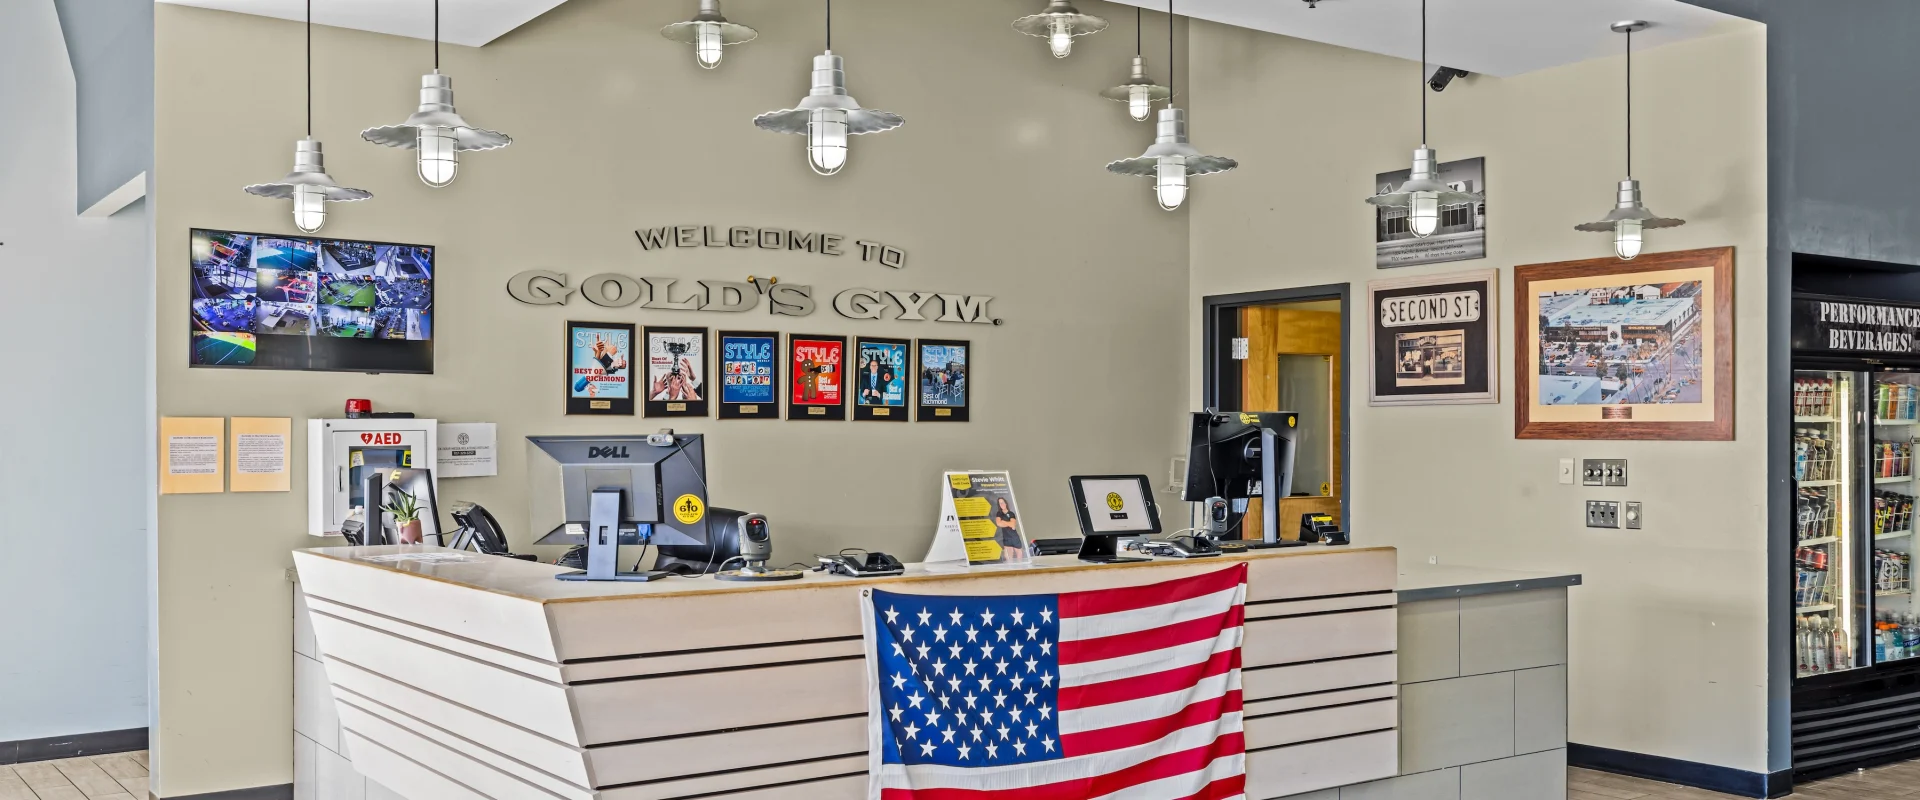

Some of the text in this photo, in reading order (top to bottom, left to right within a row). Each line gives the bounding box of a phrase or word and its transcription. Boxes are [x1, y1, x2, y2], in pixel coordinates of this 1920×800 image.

[635, 225, 906, 269] WELCOME TO
[506, 268, 817, 317] GOLD'S
[1389, 296, 1472, 323] SECOND ST.
[1820, 301, 1920, 328] PERFORMANCE
[576, 330, 628, 349] STYLE
[1829, 328, 1912, 352] BEVERAGES!
[725, 342, 770, 360] STYLE
[796, 346, 839, 363] STYLE
[862, 348, 903, 365] STYLE
[374, 432, 402, 445] AED
[588, 445, 630, 459] DELL
